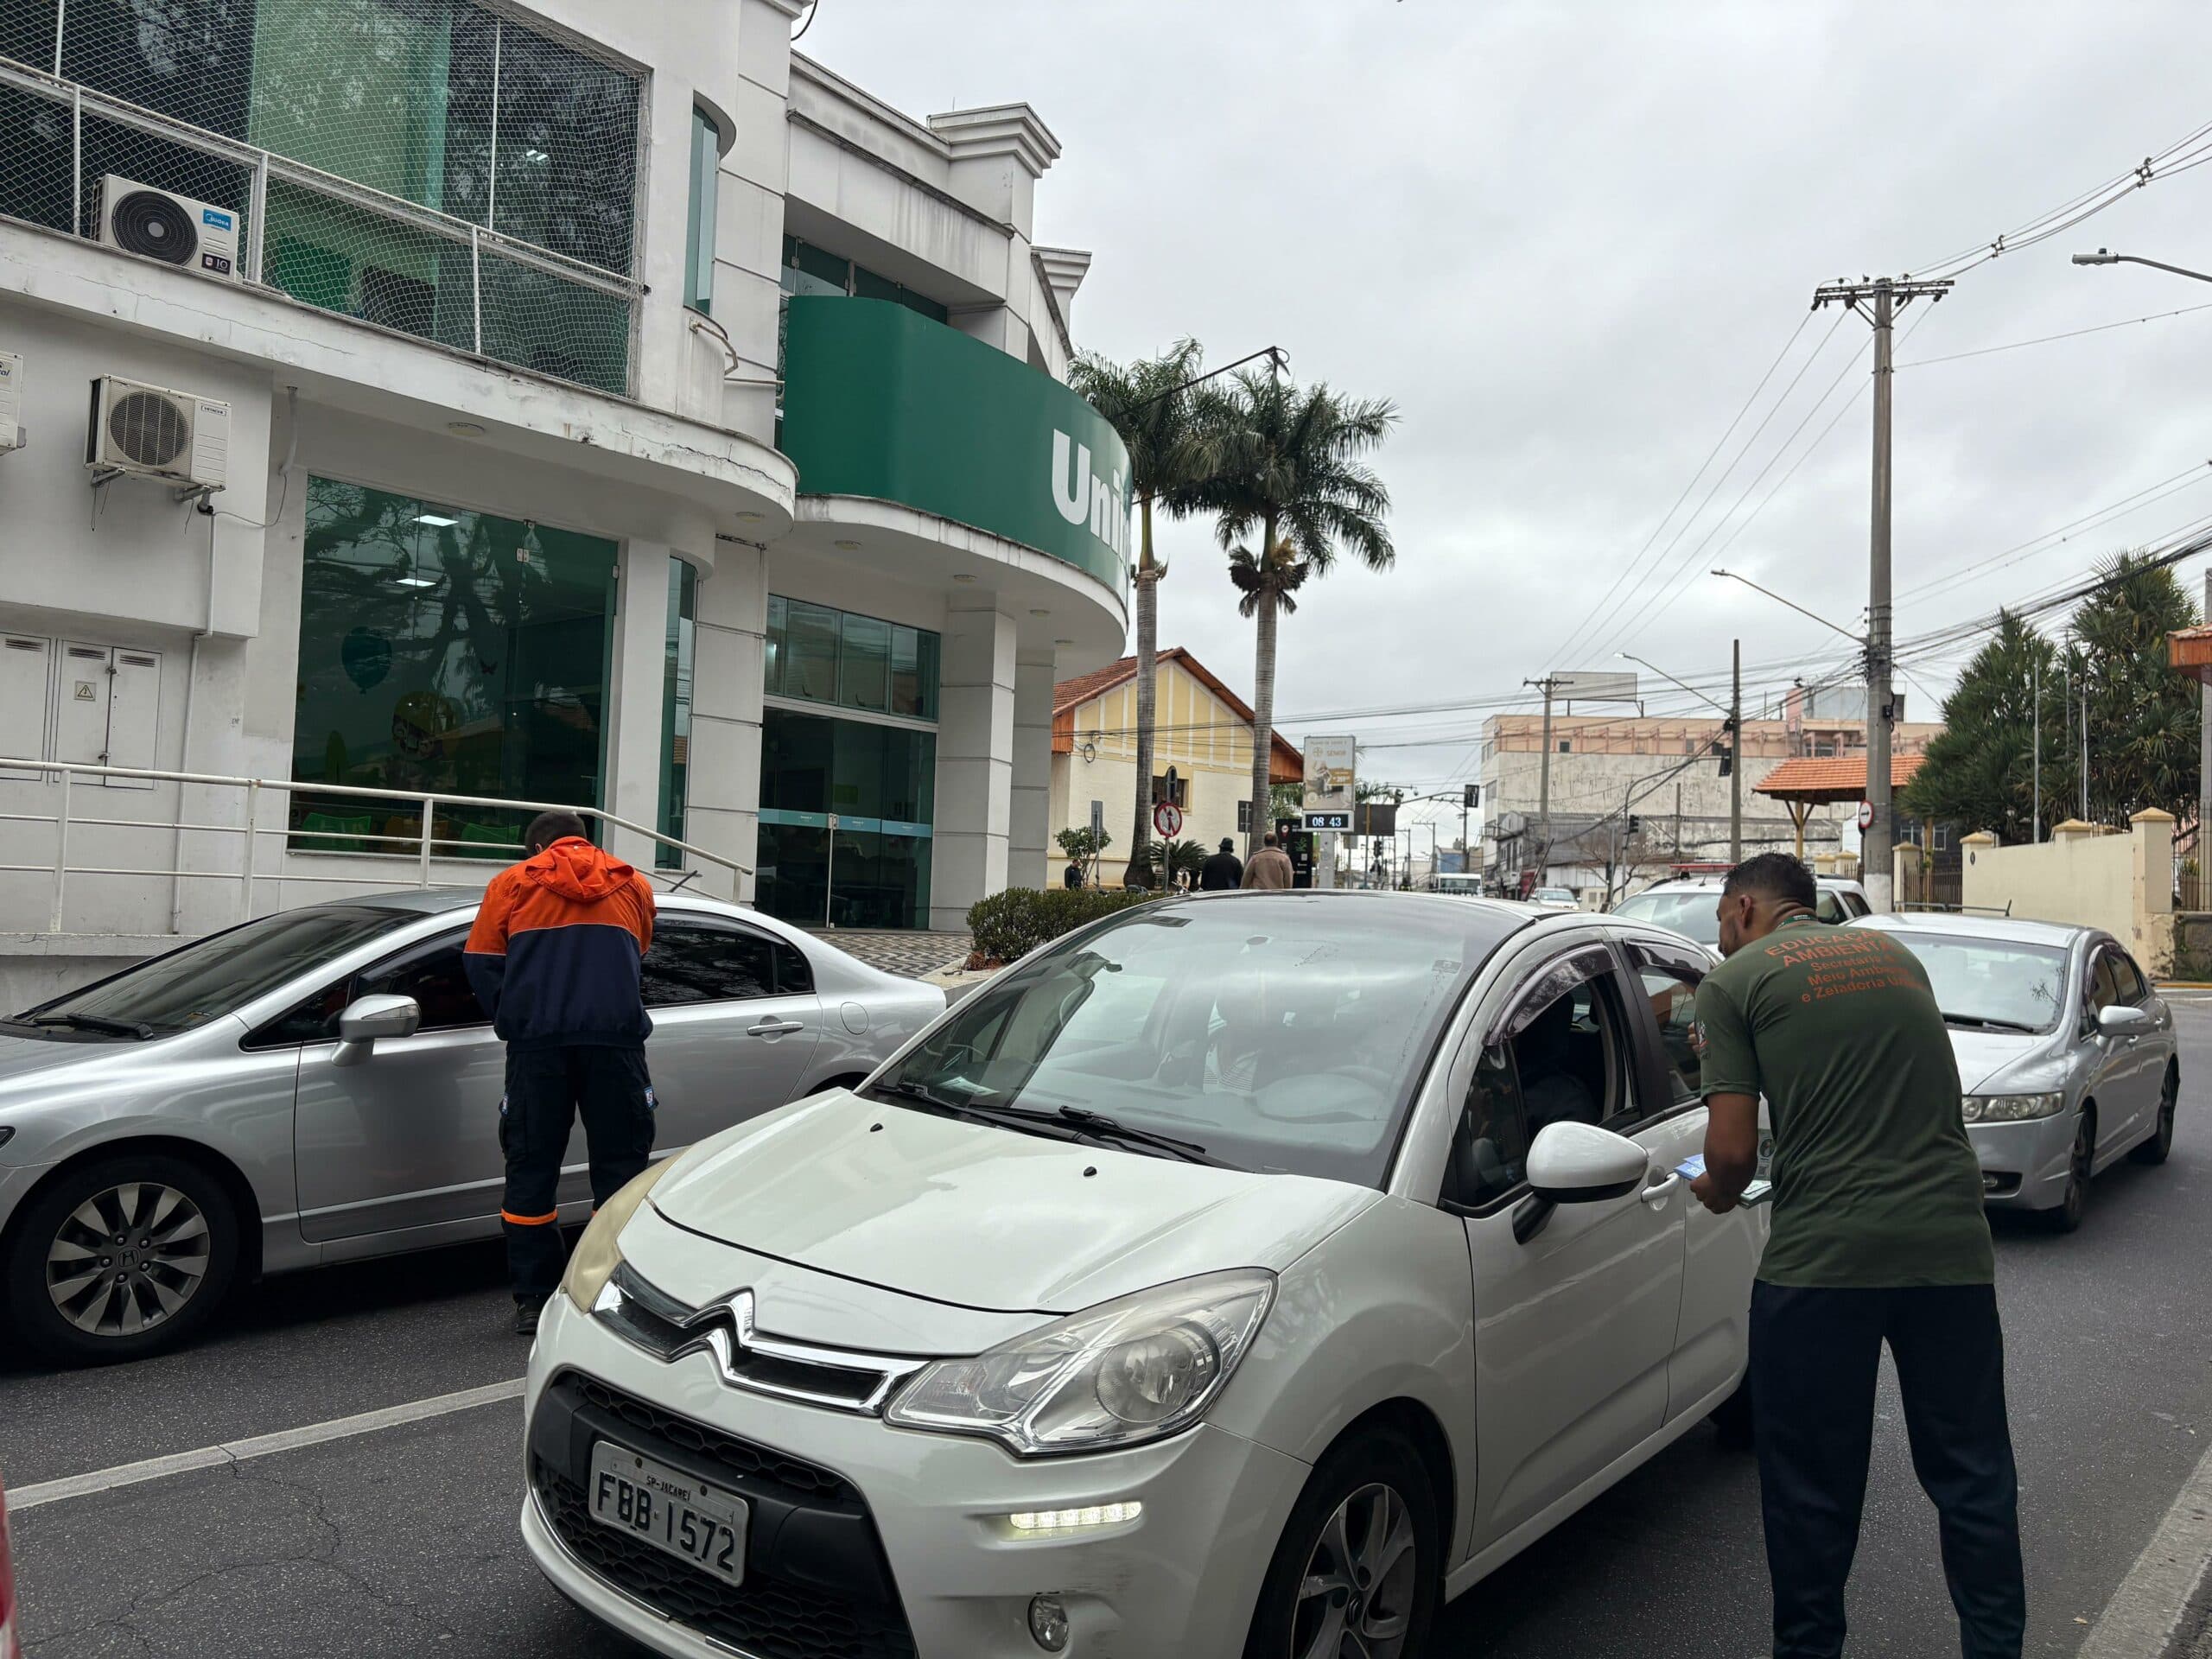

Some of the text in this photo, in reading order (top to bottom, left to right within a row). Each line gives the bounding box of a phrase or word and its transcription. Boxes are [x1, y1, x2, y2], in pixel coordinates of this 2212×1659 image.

[1052, 429, 1128, 560] Uni
[1313, 817, 1341, 827] 08 43
[1849, 966, 1909, 980] Ambi
[1802, 994, 1811, 1002] e
